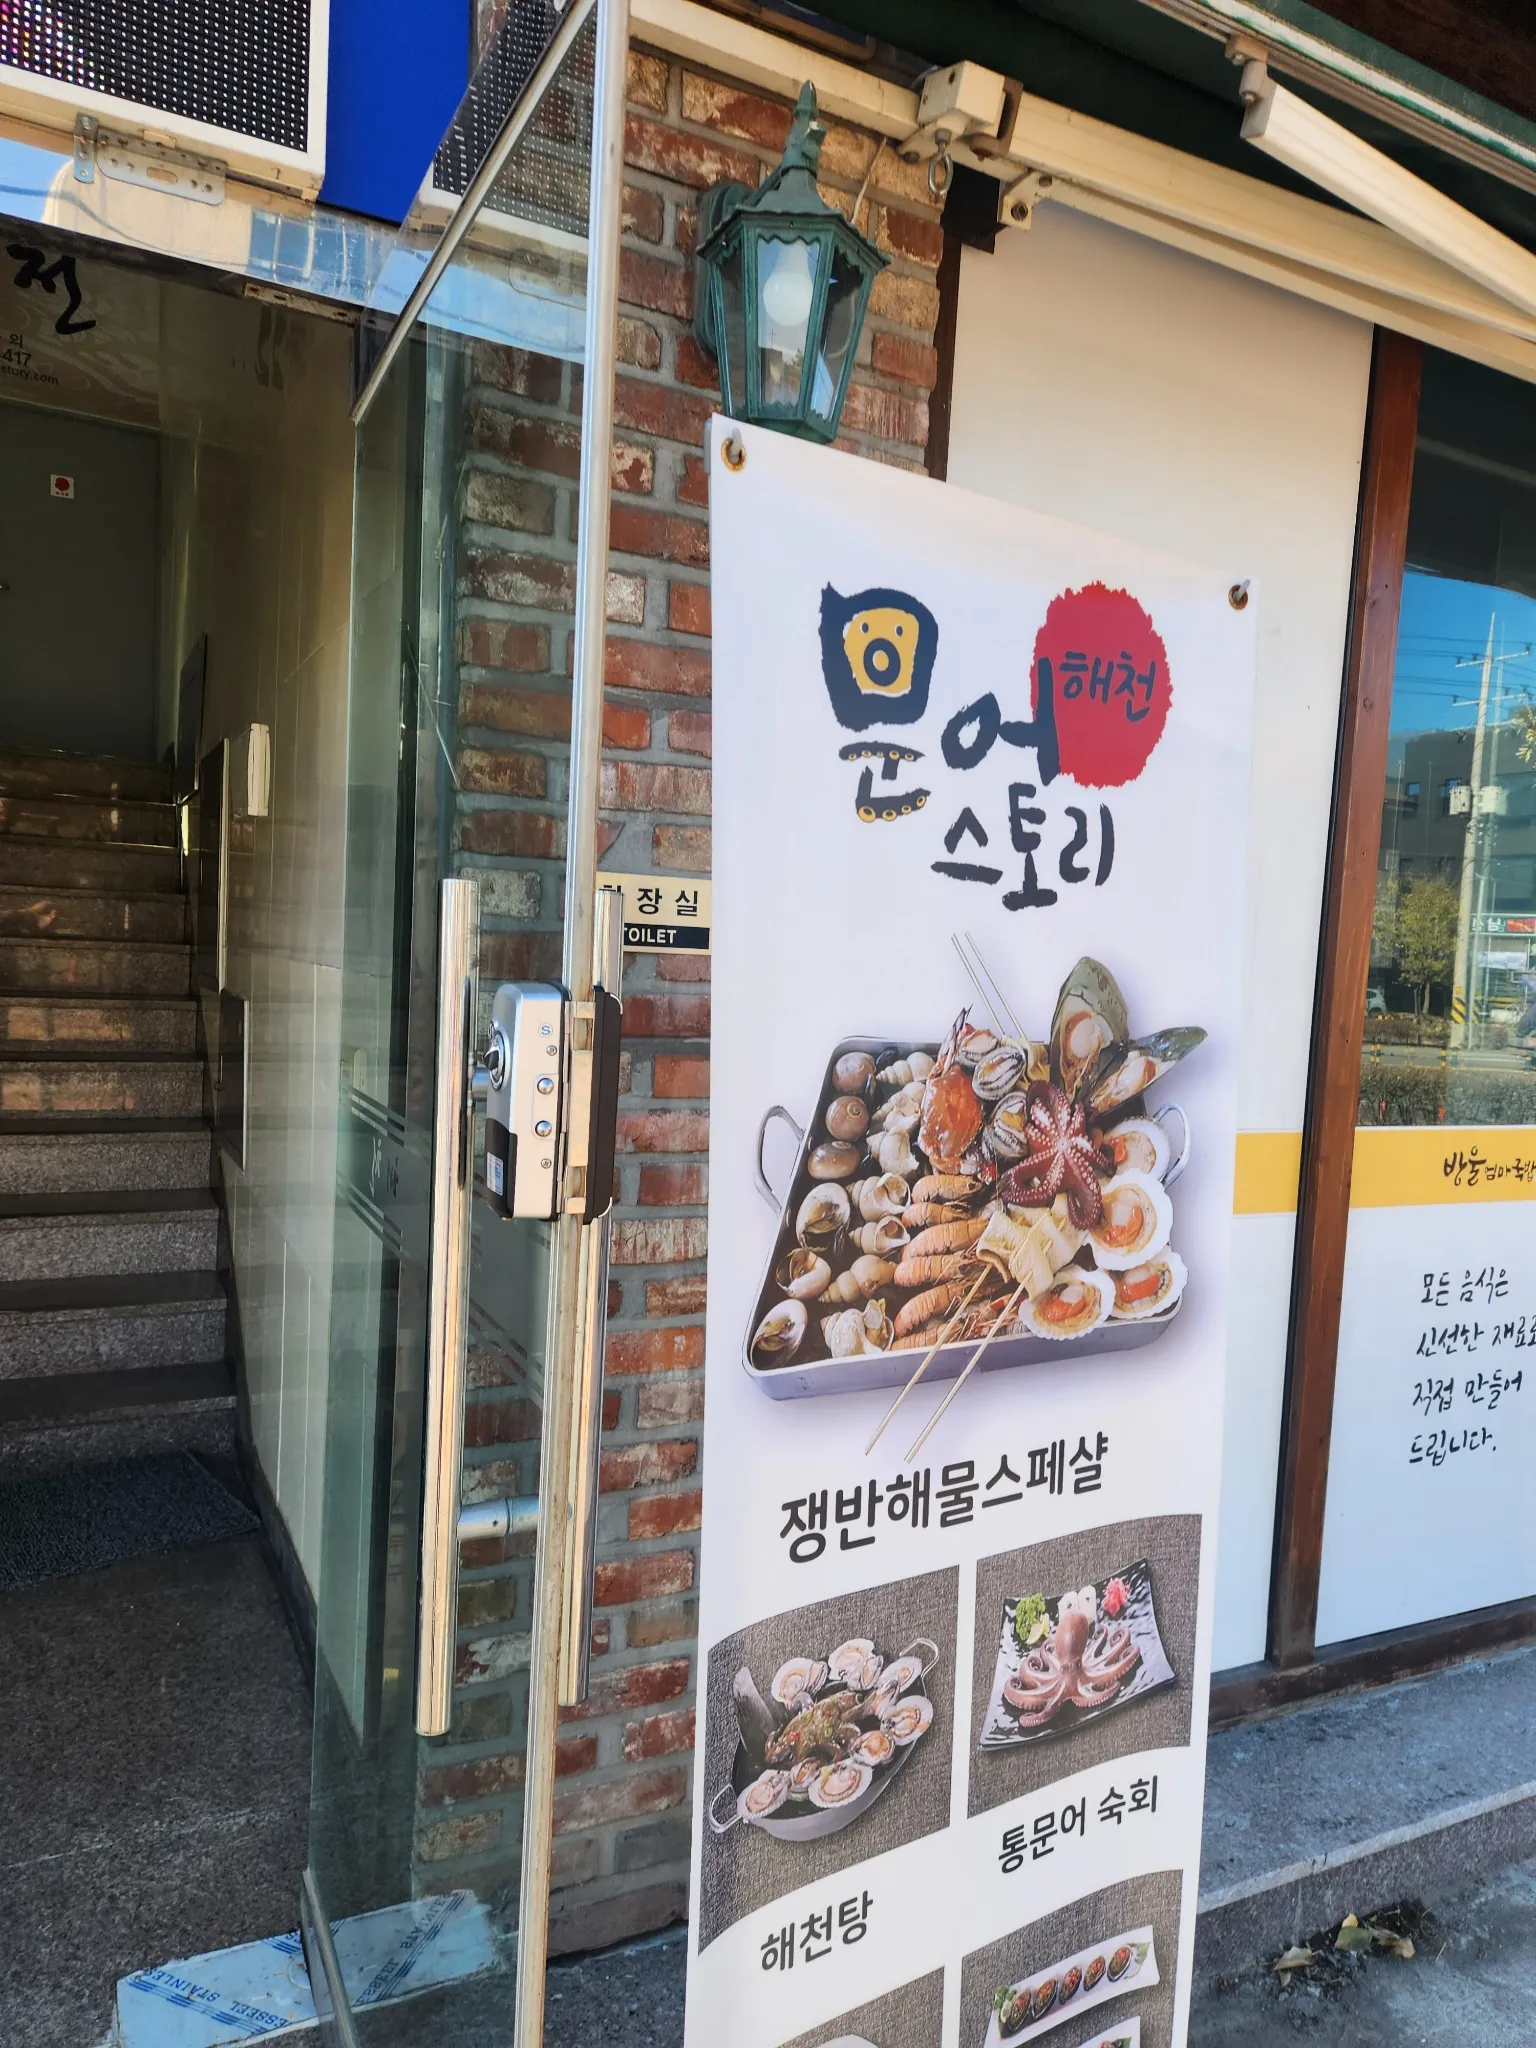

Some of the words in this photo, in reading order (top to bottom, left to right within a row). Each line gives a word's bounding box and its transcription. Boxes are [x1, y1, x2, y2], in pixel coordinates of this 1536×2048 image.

[818, 579, 1061, 824] 문어
[1059, 649, 1156, 723] 해천
[930, 781, 1115, 912] 스토리
[1421, 1272, 1450, 1306] 모든
[1460, 1266, 1509, 1304] 음식은
[1416, 1322, 1485, 1357] 신선한
[1412, 1377, 1454, 1416] 직접
[1465, 1369, 1523, 1410] 만들어
[1409, 1427, 1496, 1467] 드립니다.
[780, 1431, 1109, 1563] 쟁반해물스페샬
[998, 1796, 1086, 1874] 통문어
[1097, 1775, 1158, 1825] 숙회
[760, 1890, 874, 1971] 해천탕
